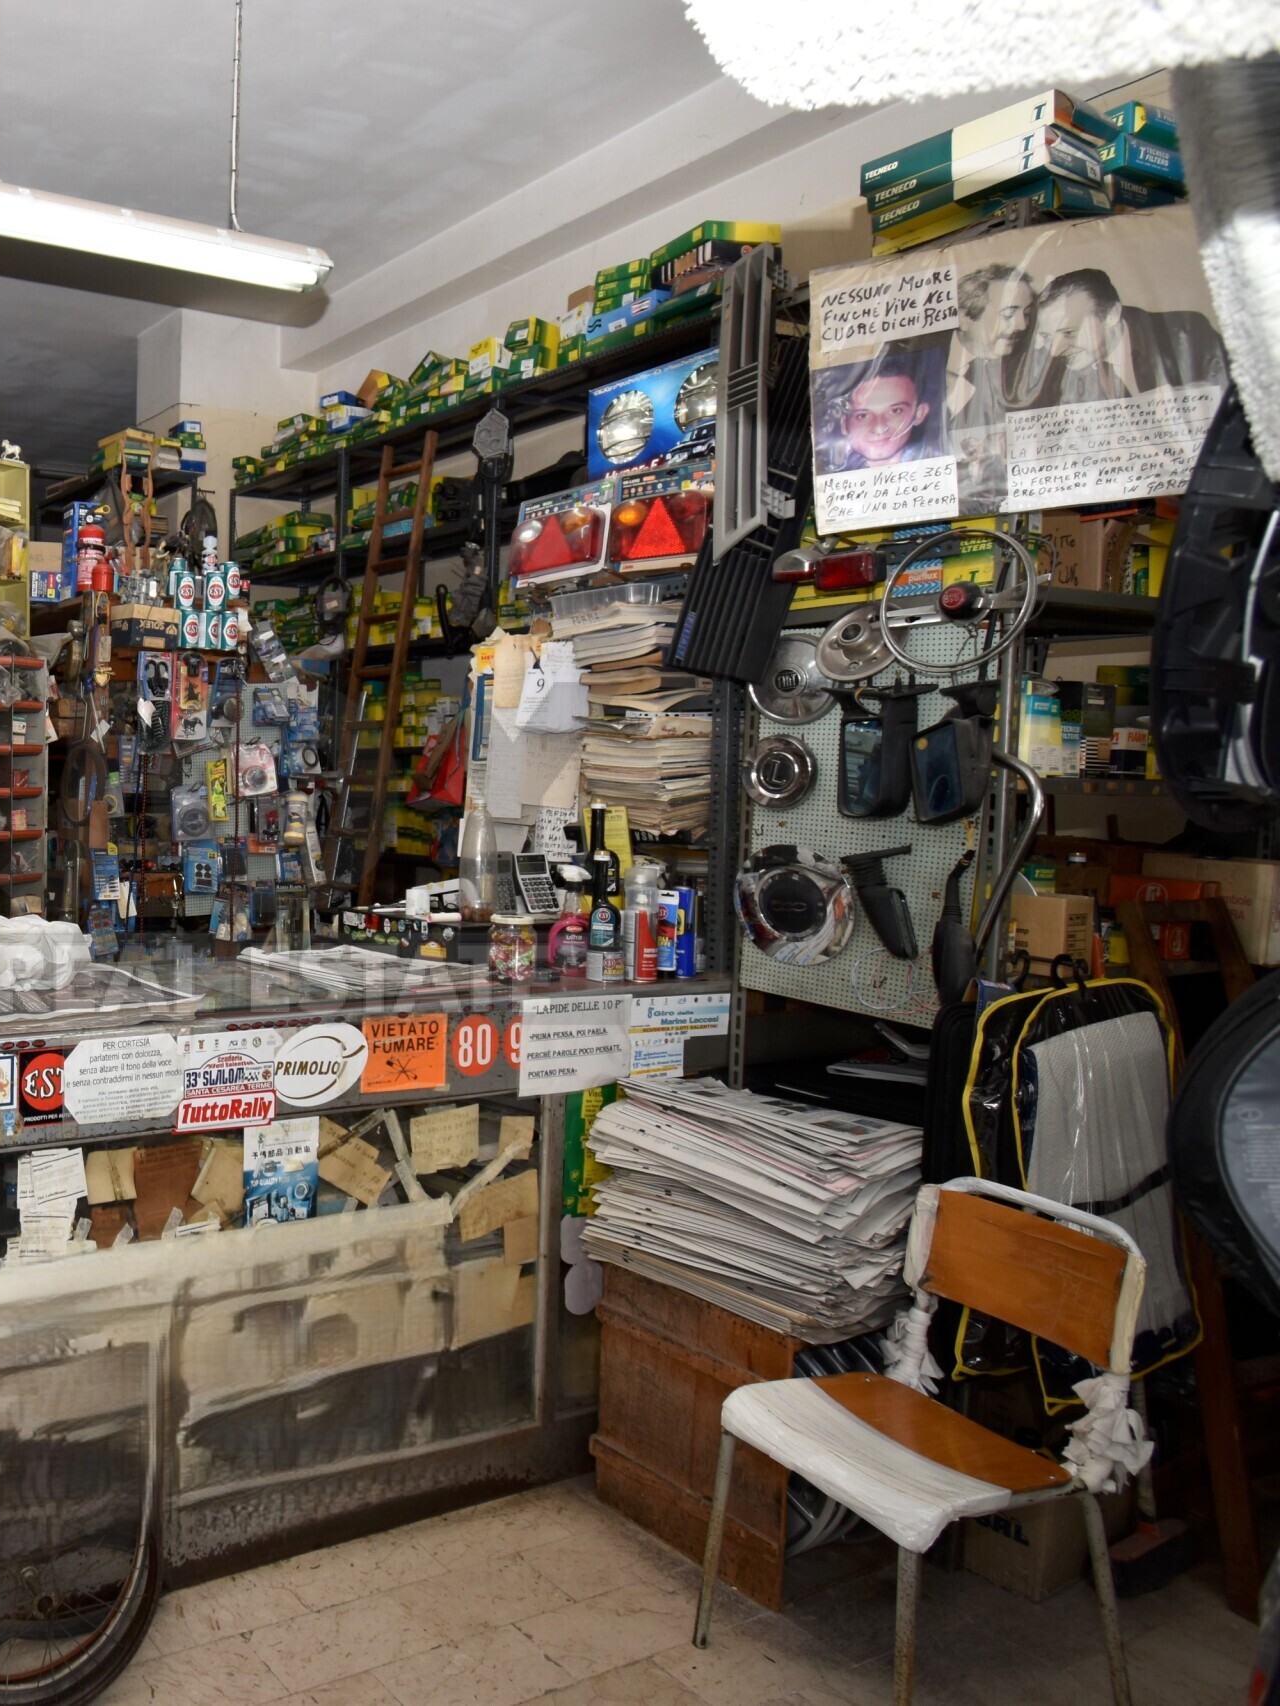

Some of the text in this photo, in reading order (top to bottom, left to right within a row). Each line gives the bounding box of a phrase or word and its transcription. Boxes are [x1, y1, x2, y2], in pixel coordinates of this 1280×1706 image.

[865, 161, 899, 180] TECNECO
[874, 179, 917, 202] TECNECO
[879, 200, 920, 223] TECNECO
[821, 270, 953, 308] NESSUNO MUORE
[885, 290, 954, 317] VIVE NEL
[822, 322, 877, 341] CUORE
[824, 464, 953, 492] MEGLIO VIVERE 365
[873, 489, 889, 498] DA
[896, 481, 941, 496] LEONE
[828, 505, 854, 518] CHE
[862, 502, 886, 513] UNO
[892, 501, 907, 510] DA
[536, 678, 545, 693] 9
[571, 1001, 612, 1014] DELLE 10
[689, 1015, 719, 1023] Leccesi
[371, 1021, 439, 1038] VIETATO
[576, 1029, 586, 1037] POI
[103, 1038, 150, 1049] PER CORTESIA
[372, 1037, 436, 1054] FUMARE
[458, 1024, 492, 1068] 80
[89, 1055, 120, 1064] parlatemi
[134, 1049, 162, 1058] dolcezza,
[552, 1049, 577, 1058] PAROLE
[578, 1047, 594, 1056] POCO
[79, 1068, 98, 1076] senza
[100, 1065, 119, 1073] alzare
[142, 1061, 156, 1069] della
[158, 1059, 172, 1067] voce
[528, 1069, 557, 1079] PORTANO
[72, 1080, 91, 1088] senza
[92, 1075, 133, 1086] contraddirmi
[142, 1071, 164, 1079] nessun
[186, 1082, 272, 1097] SANTA CESAREA TERME
[23, 1114, 48, 1122] PRODOTTI
[182, 1097, 272, 1124] TuttoRally
